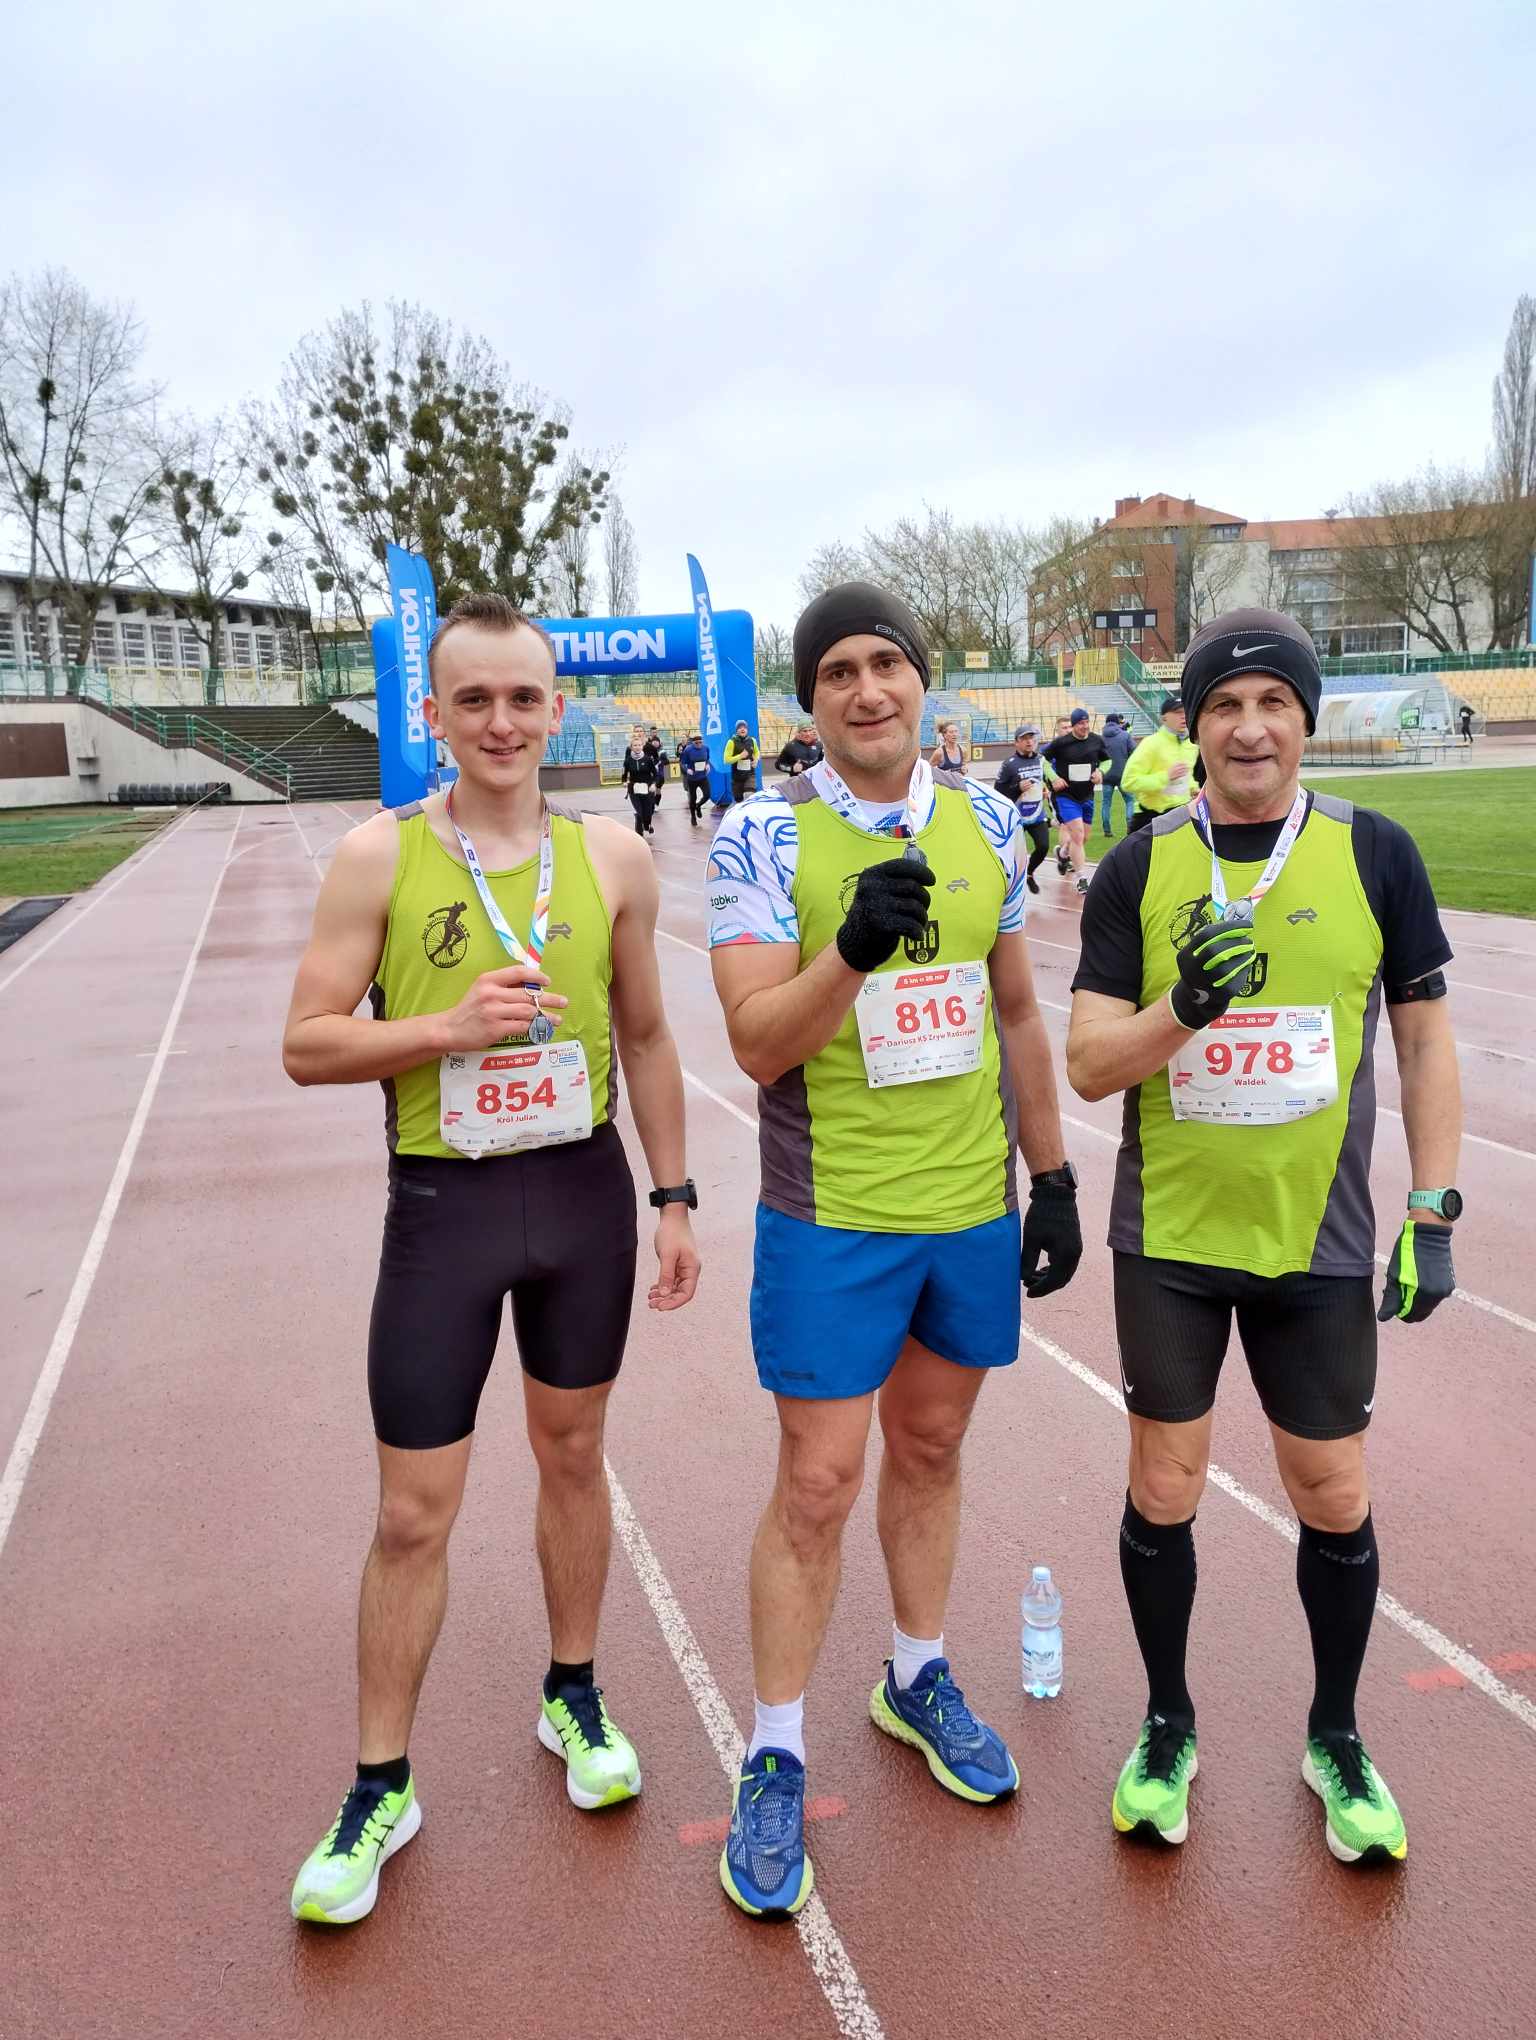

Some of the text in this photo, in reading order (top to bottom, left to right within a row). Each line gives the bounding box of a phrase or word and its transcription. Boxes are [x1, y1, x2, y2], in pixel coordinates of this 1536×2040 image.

[550, 628, 666, 662] THLON
[696, 591, 723, 736] DECATHLON
[398, 587, 427, 743] DECATHLON
[896, 995, 967, 1034] 816
[1204, 1040, 1295, 1076] 978
[476, 1076, 557, 1115] 854
[1234, 1078, 1267, 1087] Waldek
[515, 1114, 538, 1124] Julian
